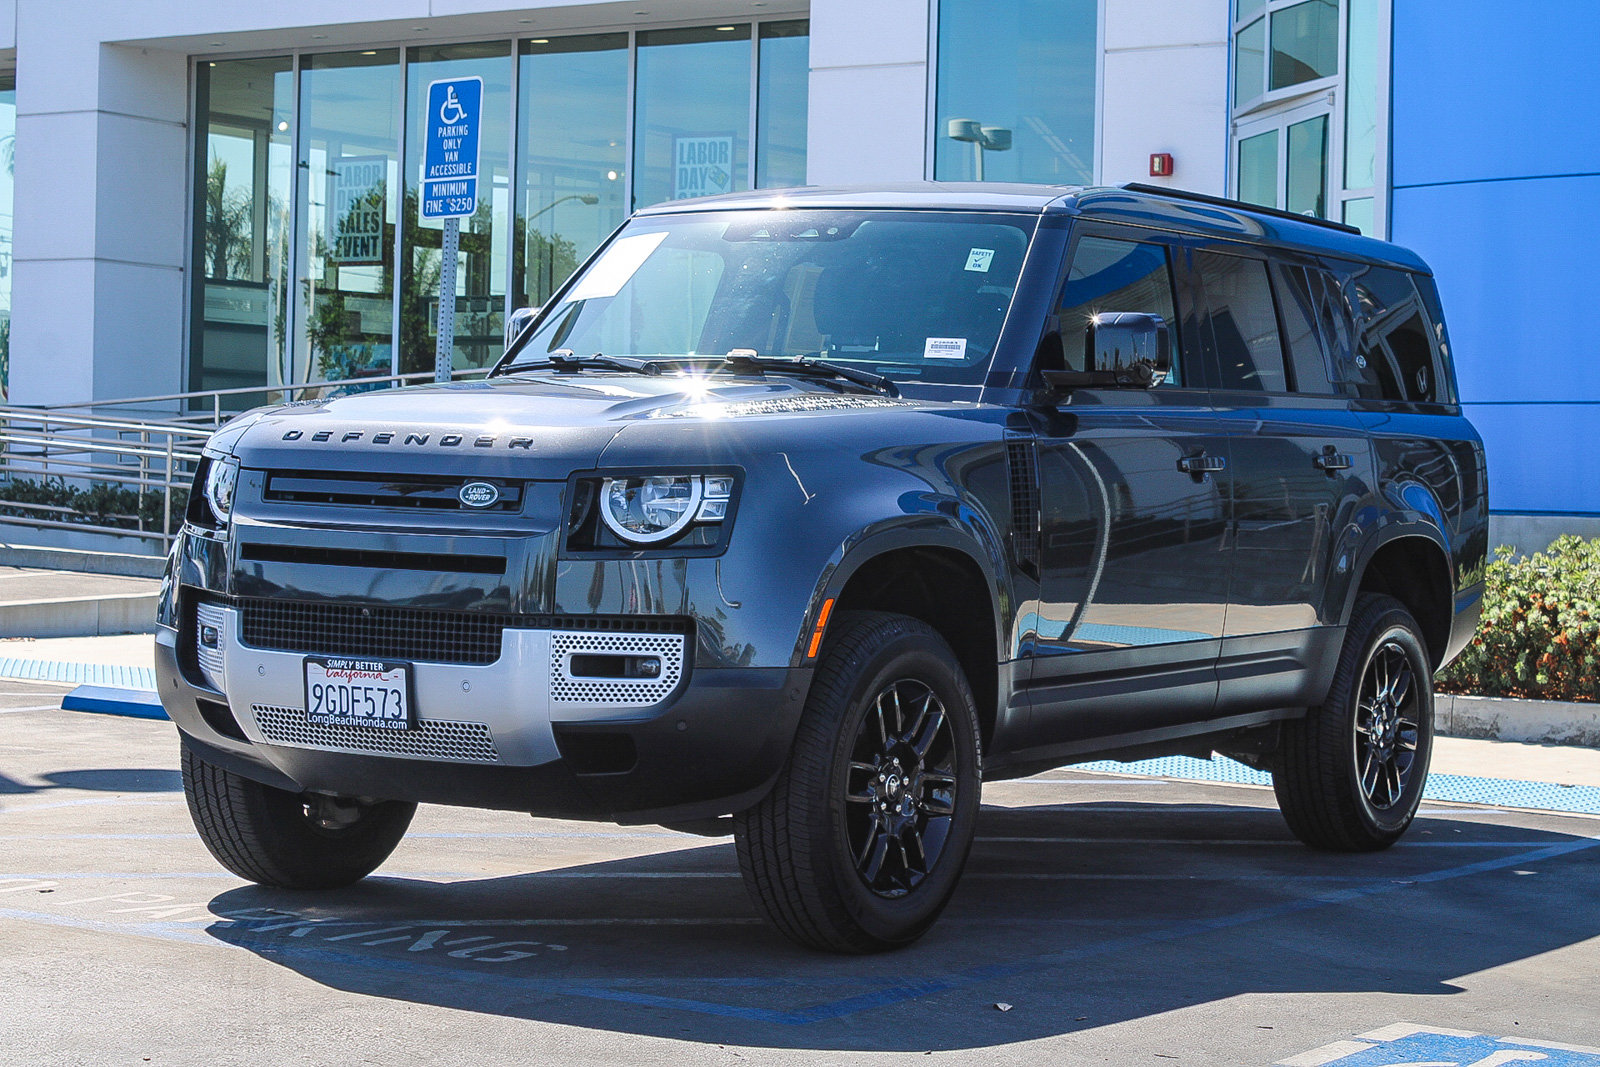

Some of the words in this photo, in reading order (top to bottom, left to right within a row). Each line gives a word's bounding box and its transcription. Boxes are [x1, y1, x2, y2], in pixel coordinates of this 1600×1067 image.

[438, 124, 469, 138] PARKING
[443, 138, 462, 150] ONLY
[444, 151, 459, 163] VAN
[679, 141, 729, 165] LABOR
[338, 164, 380, 188] LABOR
[430, 162, 472, 177] ACCESSIBLE
[678, 166, 709, 190] DAY
[432, 182, 468, 197] MINIMUM
[425, 199, 443, 213] FINE
[449, 197, 473, 213] $250
[337, 211, 380, 234] SALES
[335, 234, 380, 258] EVENT
[281, 430, 534, 450] DEFENDER
[326, 659, 353, 669] SIMPLY
[355, 661, 384, 671] BETTER
[325, 668, 389, 684] California
[312, 683, 403, 719] 9GDF573
[307, 712, 408, 730] LongBeachHonda.com
